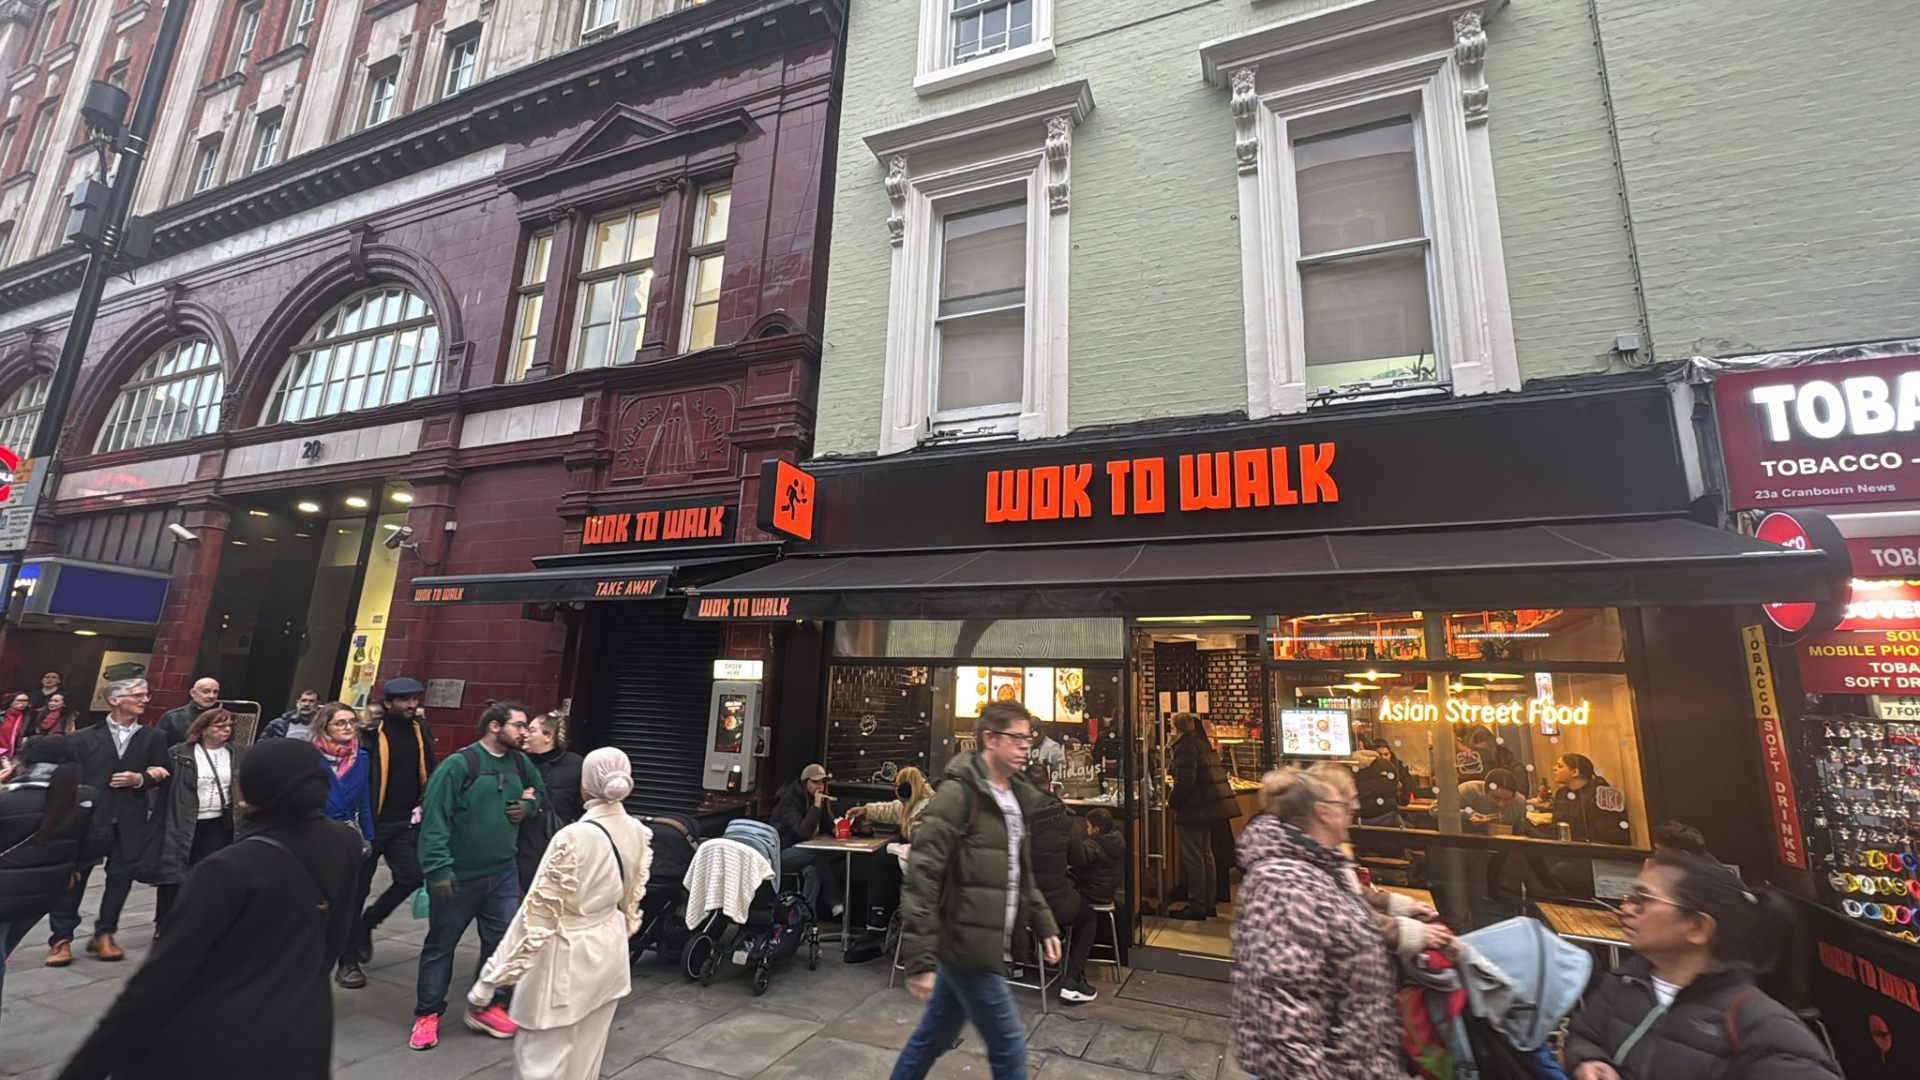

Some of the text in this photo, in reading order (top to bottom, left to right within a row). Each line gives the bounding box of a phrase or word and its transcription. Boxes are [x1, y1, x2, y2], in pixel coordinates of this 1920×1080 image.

[301, 440, 321, 459] 20
[1760, 452, 1903, 477] TOBACCO
[985, 442, 1339, 523] WOK TO WALK
[1754, 483, 1897, 499] 23a Cranbourn News
[583, 505, 725, 545] WOK TO WALK
[414, 587, 465, 602] WOK TO WALK
[595, 579, 658, 597] TAKE AWAY
[698, 597, 790, 617] WOK TO WALK
[1808, 645, 1877, 656] MOBILE
[1747, 627, 1771, 716] TOBACCO
[1869, 662, 1920, 673] TOBA
[1844, 676, 1891, 688] SOFT
[1378, 697, 1439, 722] Asian
[1444, 698, 1523, 724] Street
[1529, 698, 1589, 725] Food
[1884, 706, 1892, 715] 7
[1763, 720, 1798, 865] SOFT DRINKS
